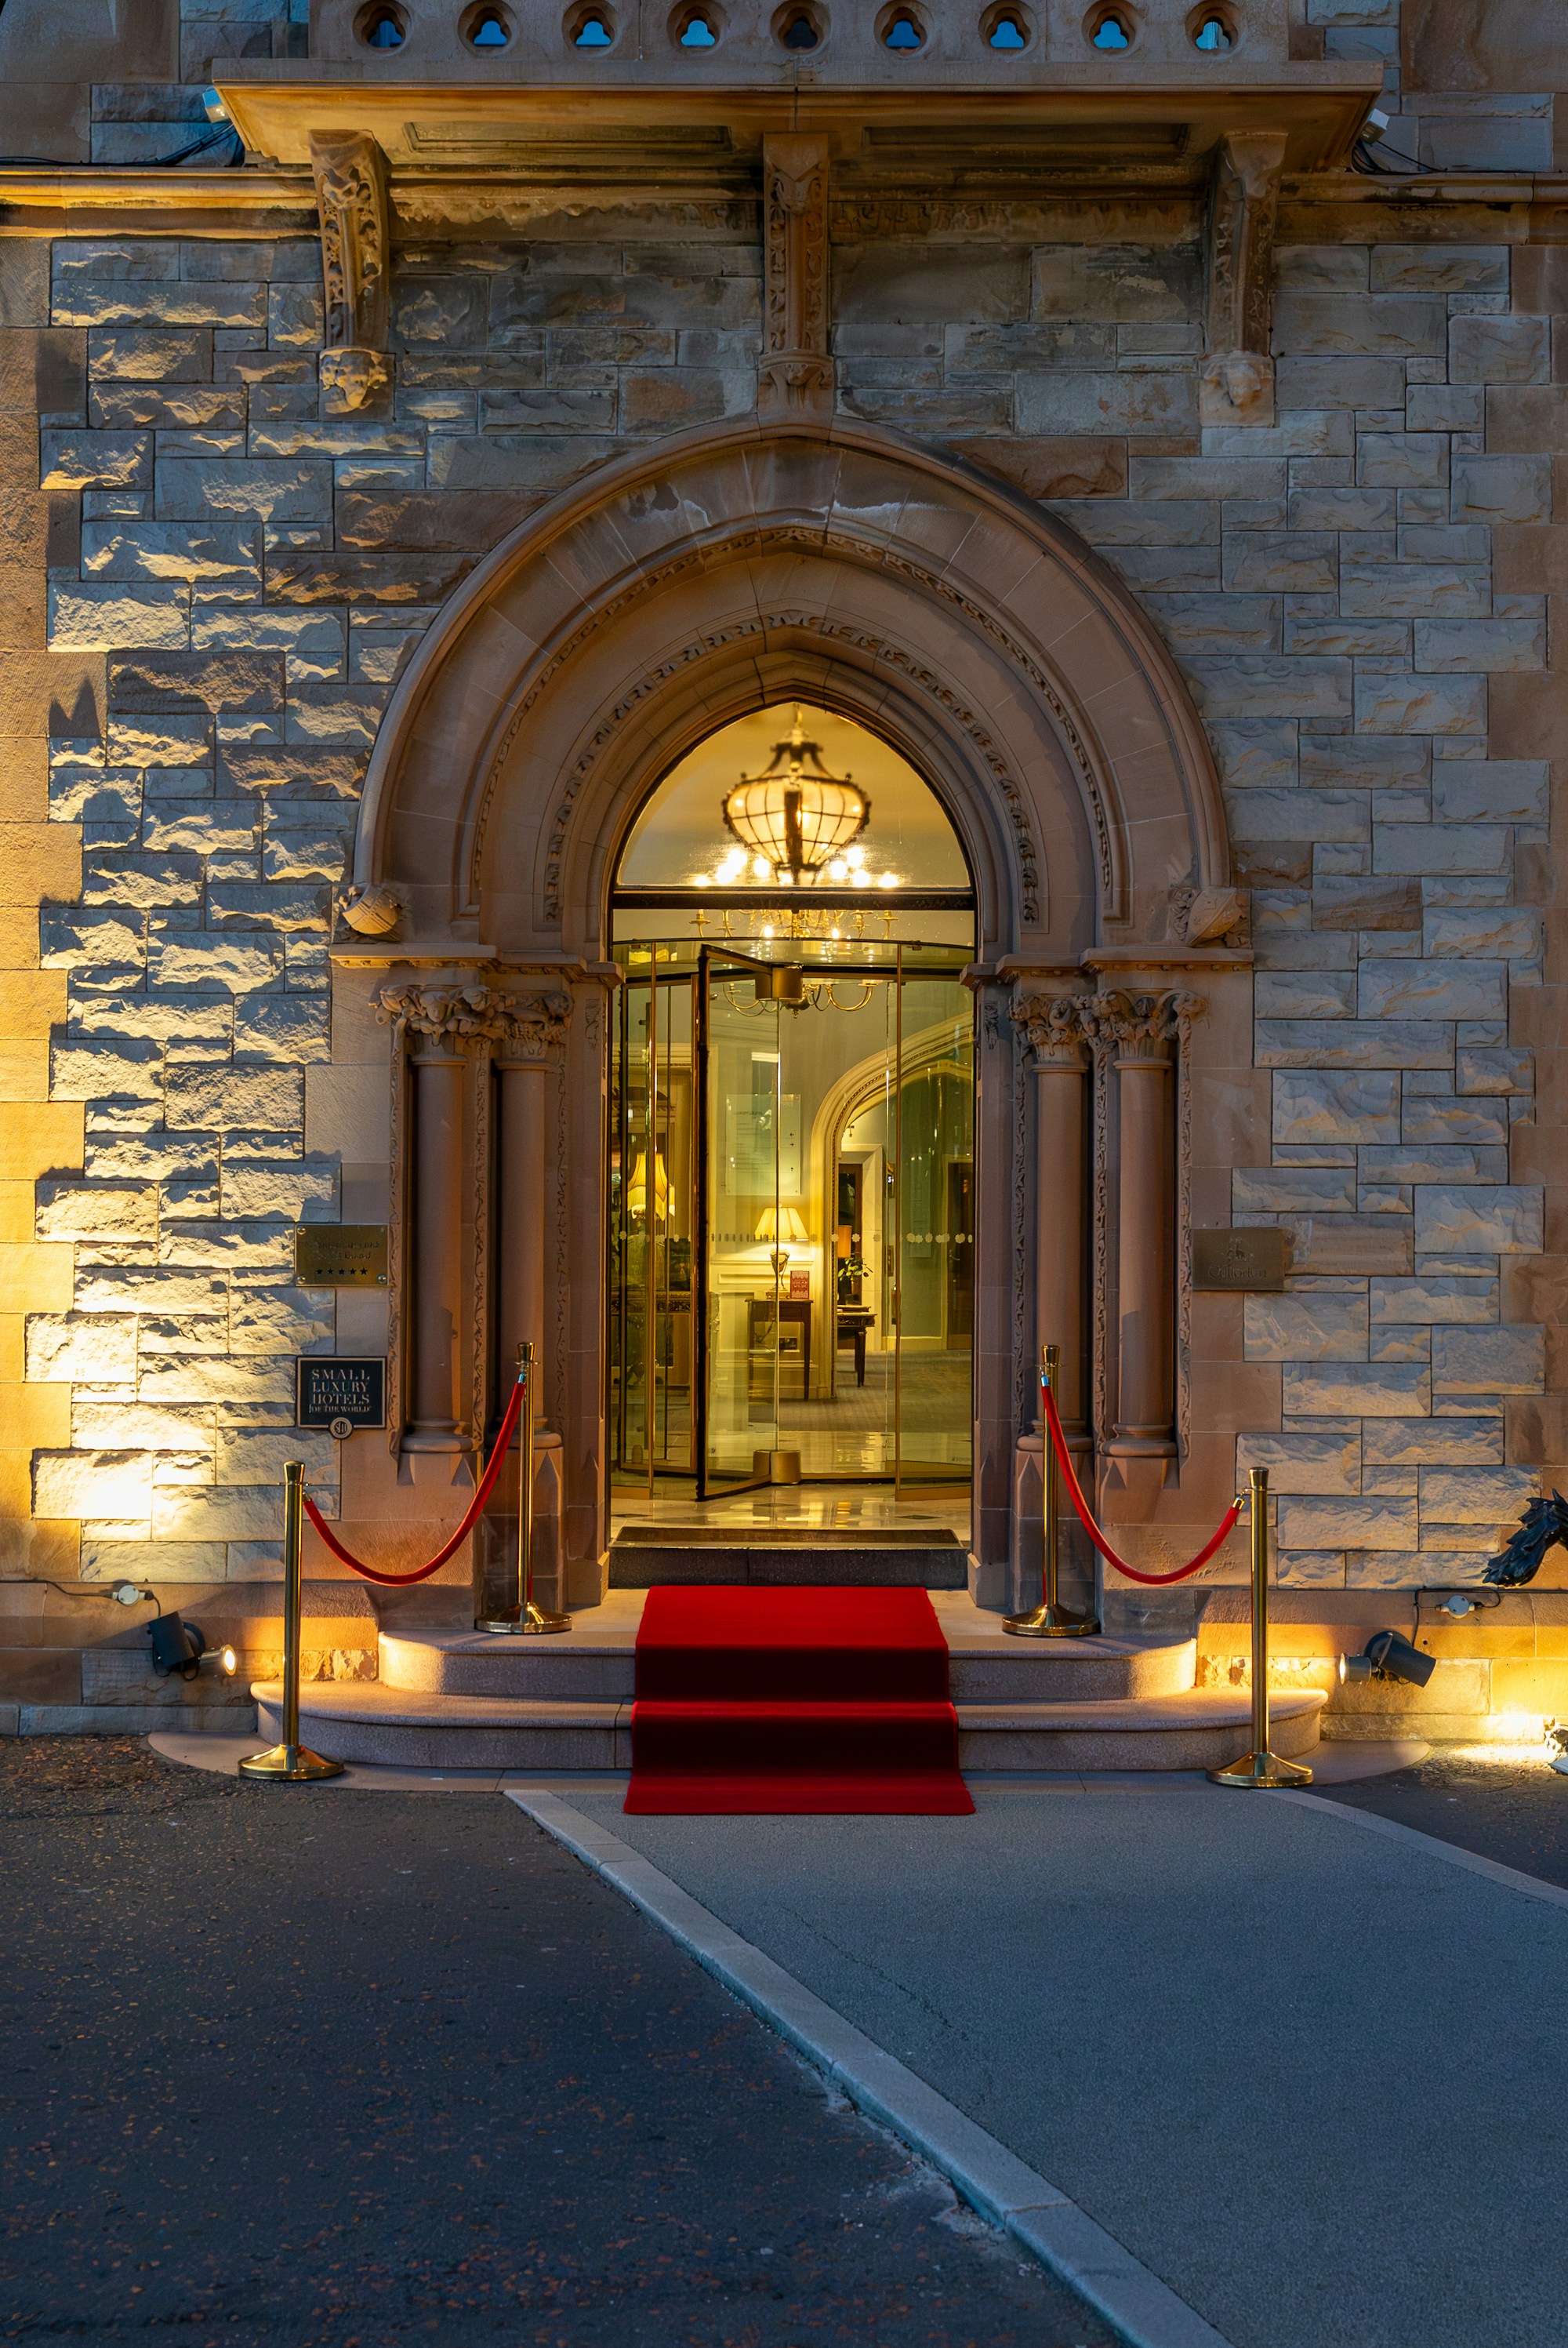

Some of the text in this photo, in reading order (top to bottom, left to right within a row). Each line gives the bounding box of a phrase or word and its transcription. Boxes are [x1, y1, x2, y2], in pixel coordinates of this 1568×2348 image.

[312, 1368, 370, 1380] SMALL
[313, 1381, 368, 1393] LUXURY
[313, 1394, 370, 1405] HOTELS
